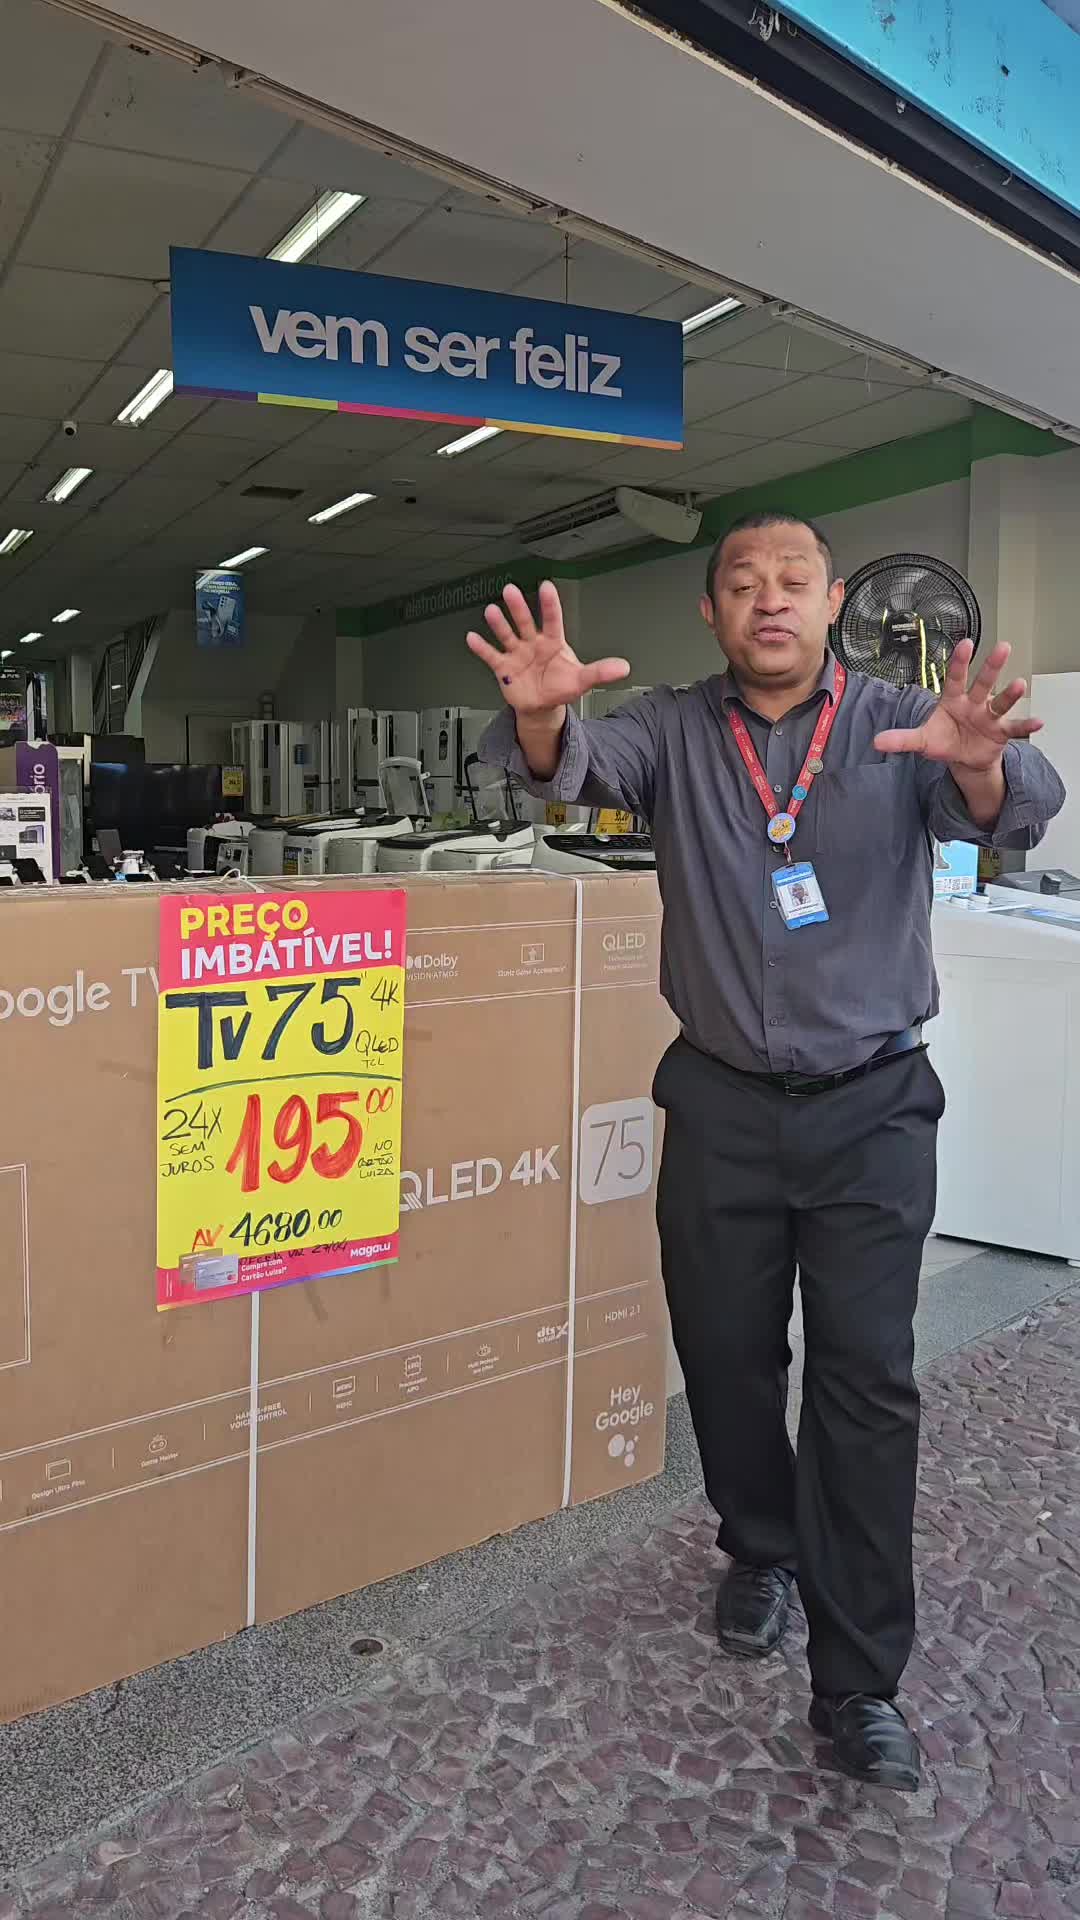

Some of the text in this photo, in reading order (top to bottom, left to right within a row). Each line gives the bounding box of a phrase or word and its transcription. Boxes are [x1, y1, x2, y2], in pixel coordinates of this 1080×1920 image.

[249, 304, 622, 398] vem ser feliz
[180, 900, 309, 940] PREÇO
[602, 933, 646, 951] QLED
[181, 927, 392, 980] IMBATÍVEL!
[424, 953, 458, 969] Dolby
[370, 977, 399, 1010] 4K
[169, 1141, 206, 1156] SEM
[225, 1092, 363, 1192] 195
[366, 1086, 394, 1114] 00
[374, 1139, 393, 1153] NO
[590, 1115, 645, 1187] 75
[160, 1155, 215, 1177] JUROS
[359, 1167, 394, 1179] LUIZA
[398, 1145, 561, 1212] QLED 4K
[192, 1224, 224, 1252] AV
[350, 1242, 391, 1258] Magalu
[241, 1258, 283, 1272] Compre com
[241, 1271, 264, 1281] Cartão
[605, 1307, 628, 1324] HDMI
[610, 1384, 641, 1407] Hey
[595, 1400, 654, 1431] Google
